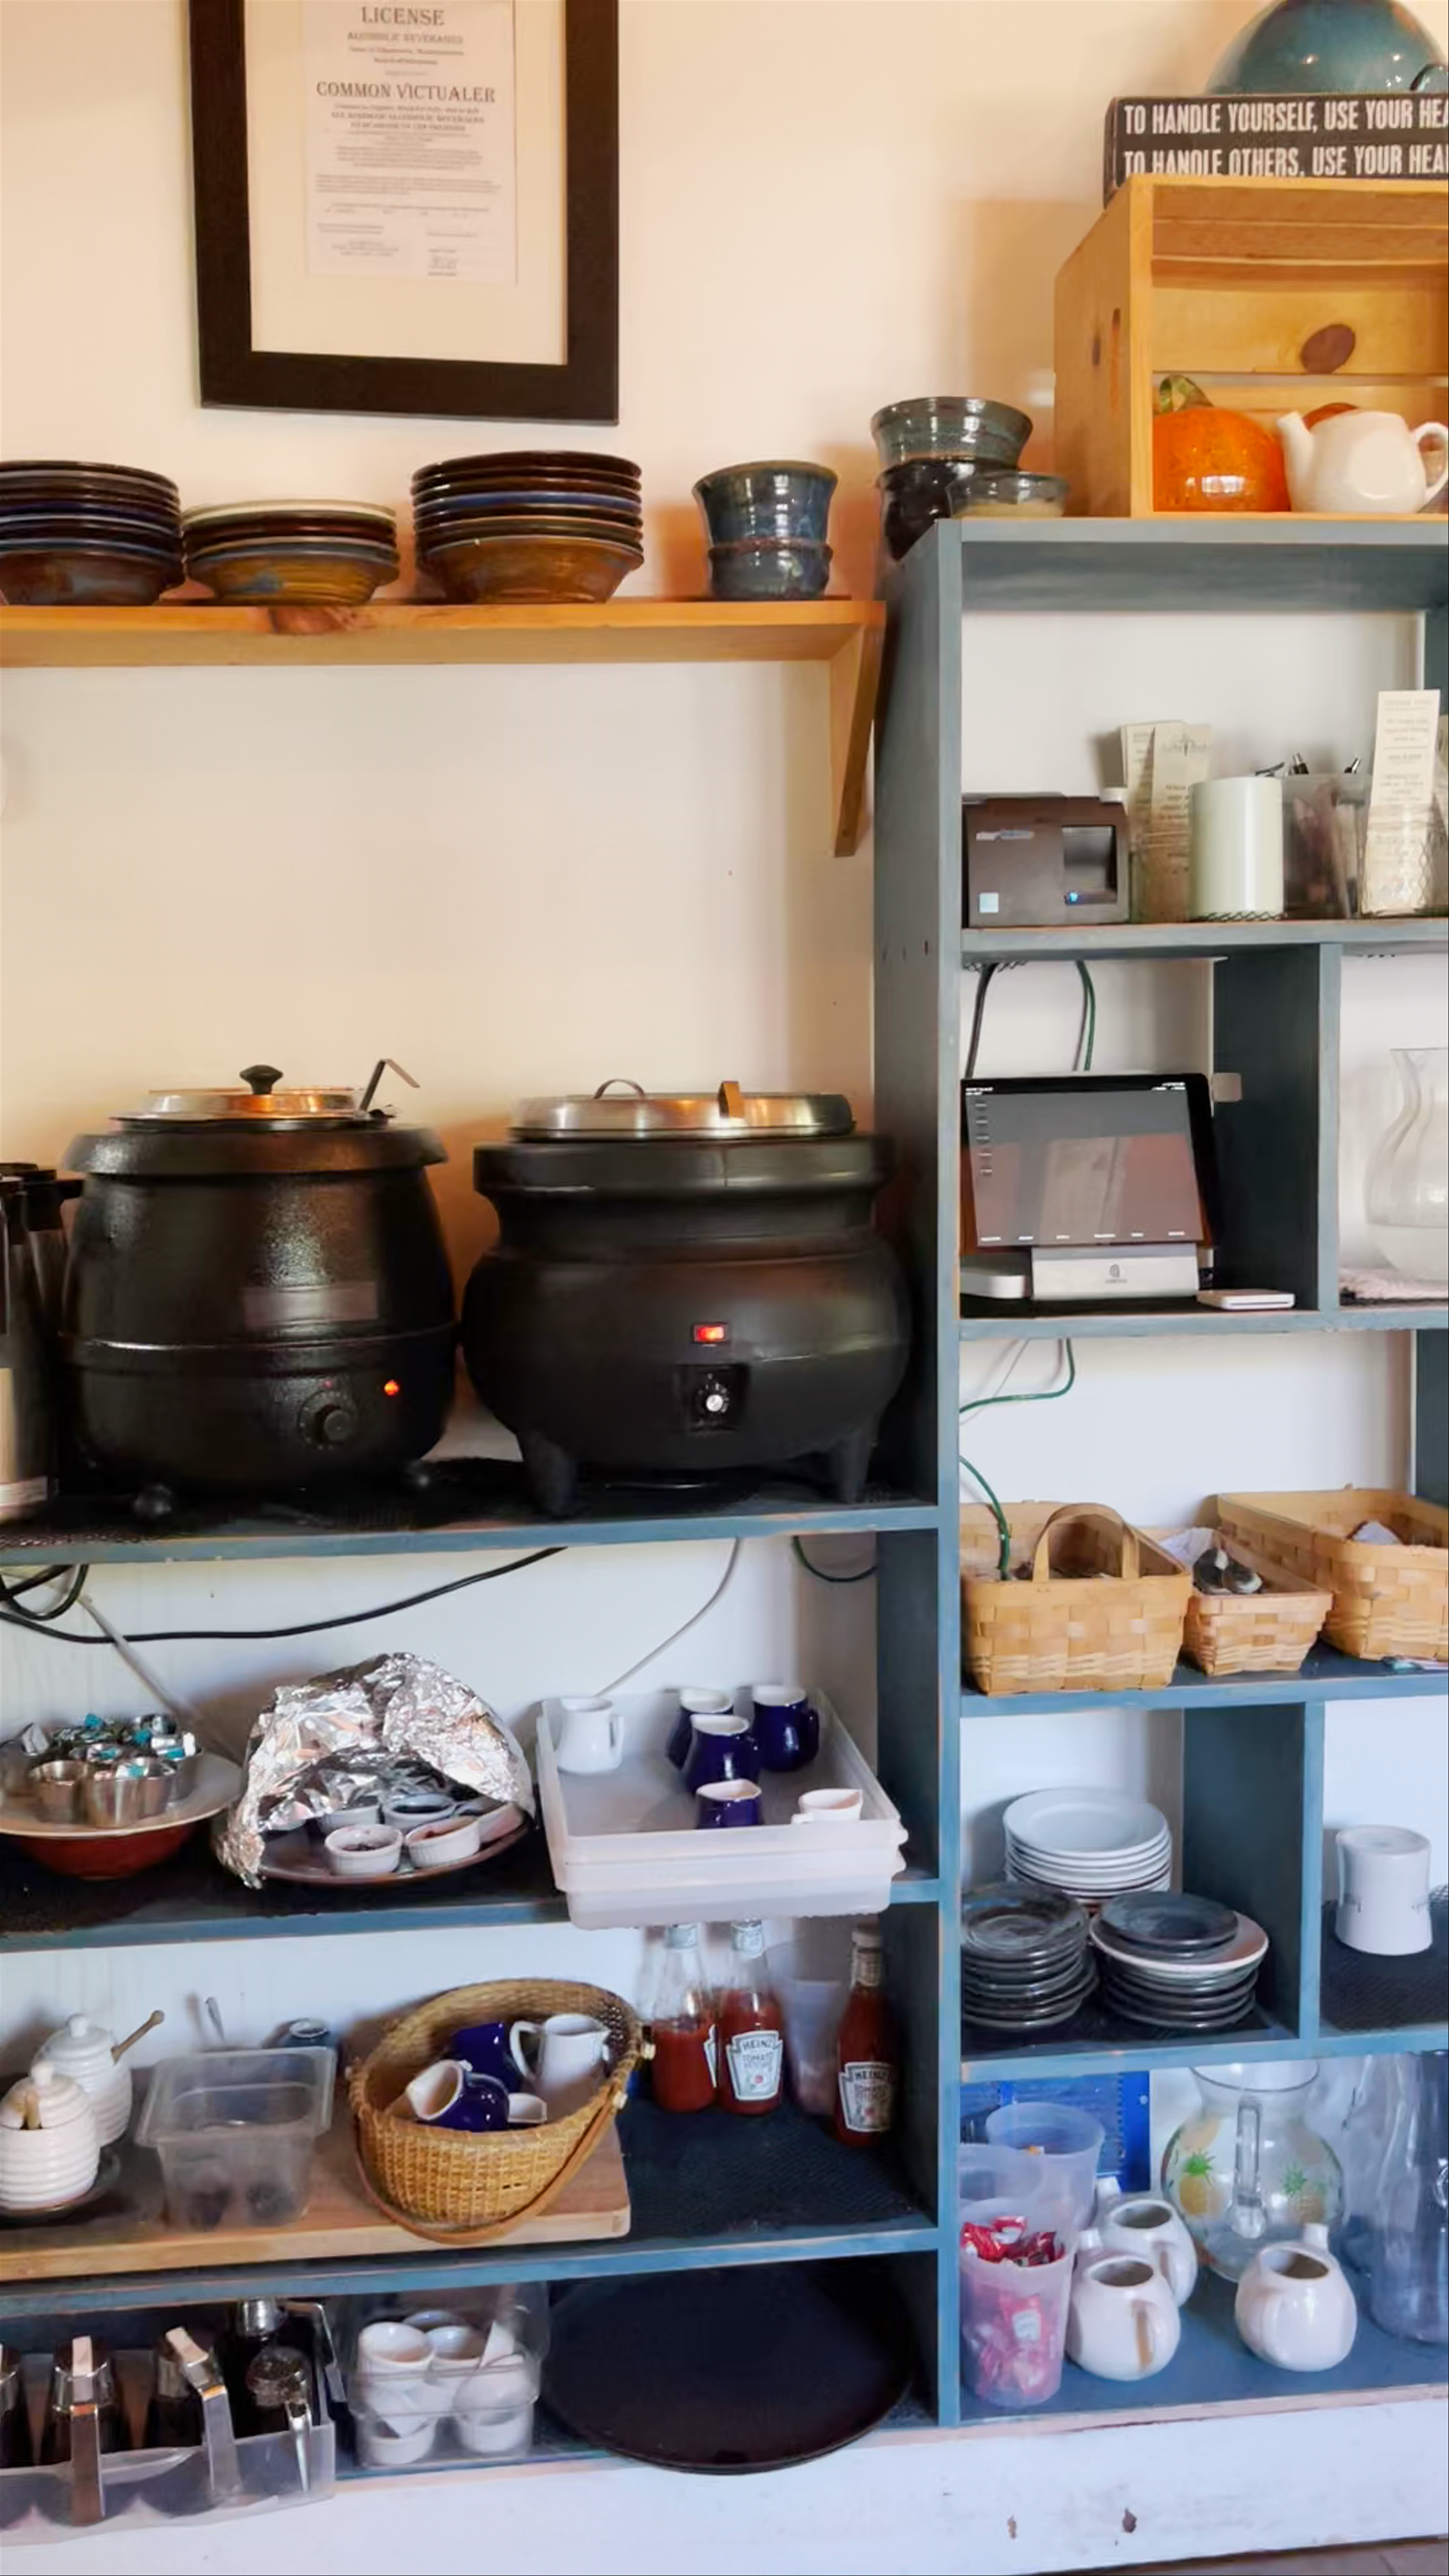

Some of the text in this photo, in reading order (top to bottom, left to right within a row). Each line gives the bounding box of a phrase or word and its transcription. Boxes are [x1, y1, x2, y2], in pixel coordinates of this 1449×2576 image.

[362, 6, 445, 26] LICENSE
[316, 81, 495, 103] COMMON VICTUALER
[1124, 105, 1146, 134] TO
[1152, 103, 1221, 134] HANDLE
[1227, 101, 1318, 134] YOURSELF,
[1324, 100, 1358, 130] USE
[1365, 99, 1413, 129] YOUR
[1124, 151, 1146, 177] TO
[1152, 149, 1222, 176] HANDLE
[1312, 146, 1347, 176] USE
[1354, 145, 1402, 174] YOUR
[1409, 143, 1448, 174] HEA
[742, 2038, 773, 2051] HEINZ
[854, 2070, 888, 2080] HEINZ
